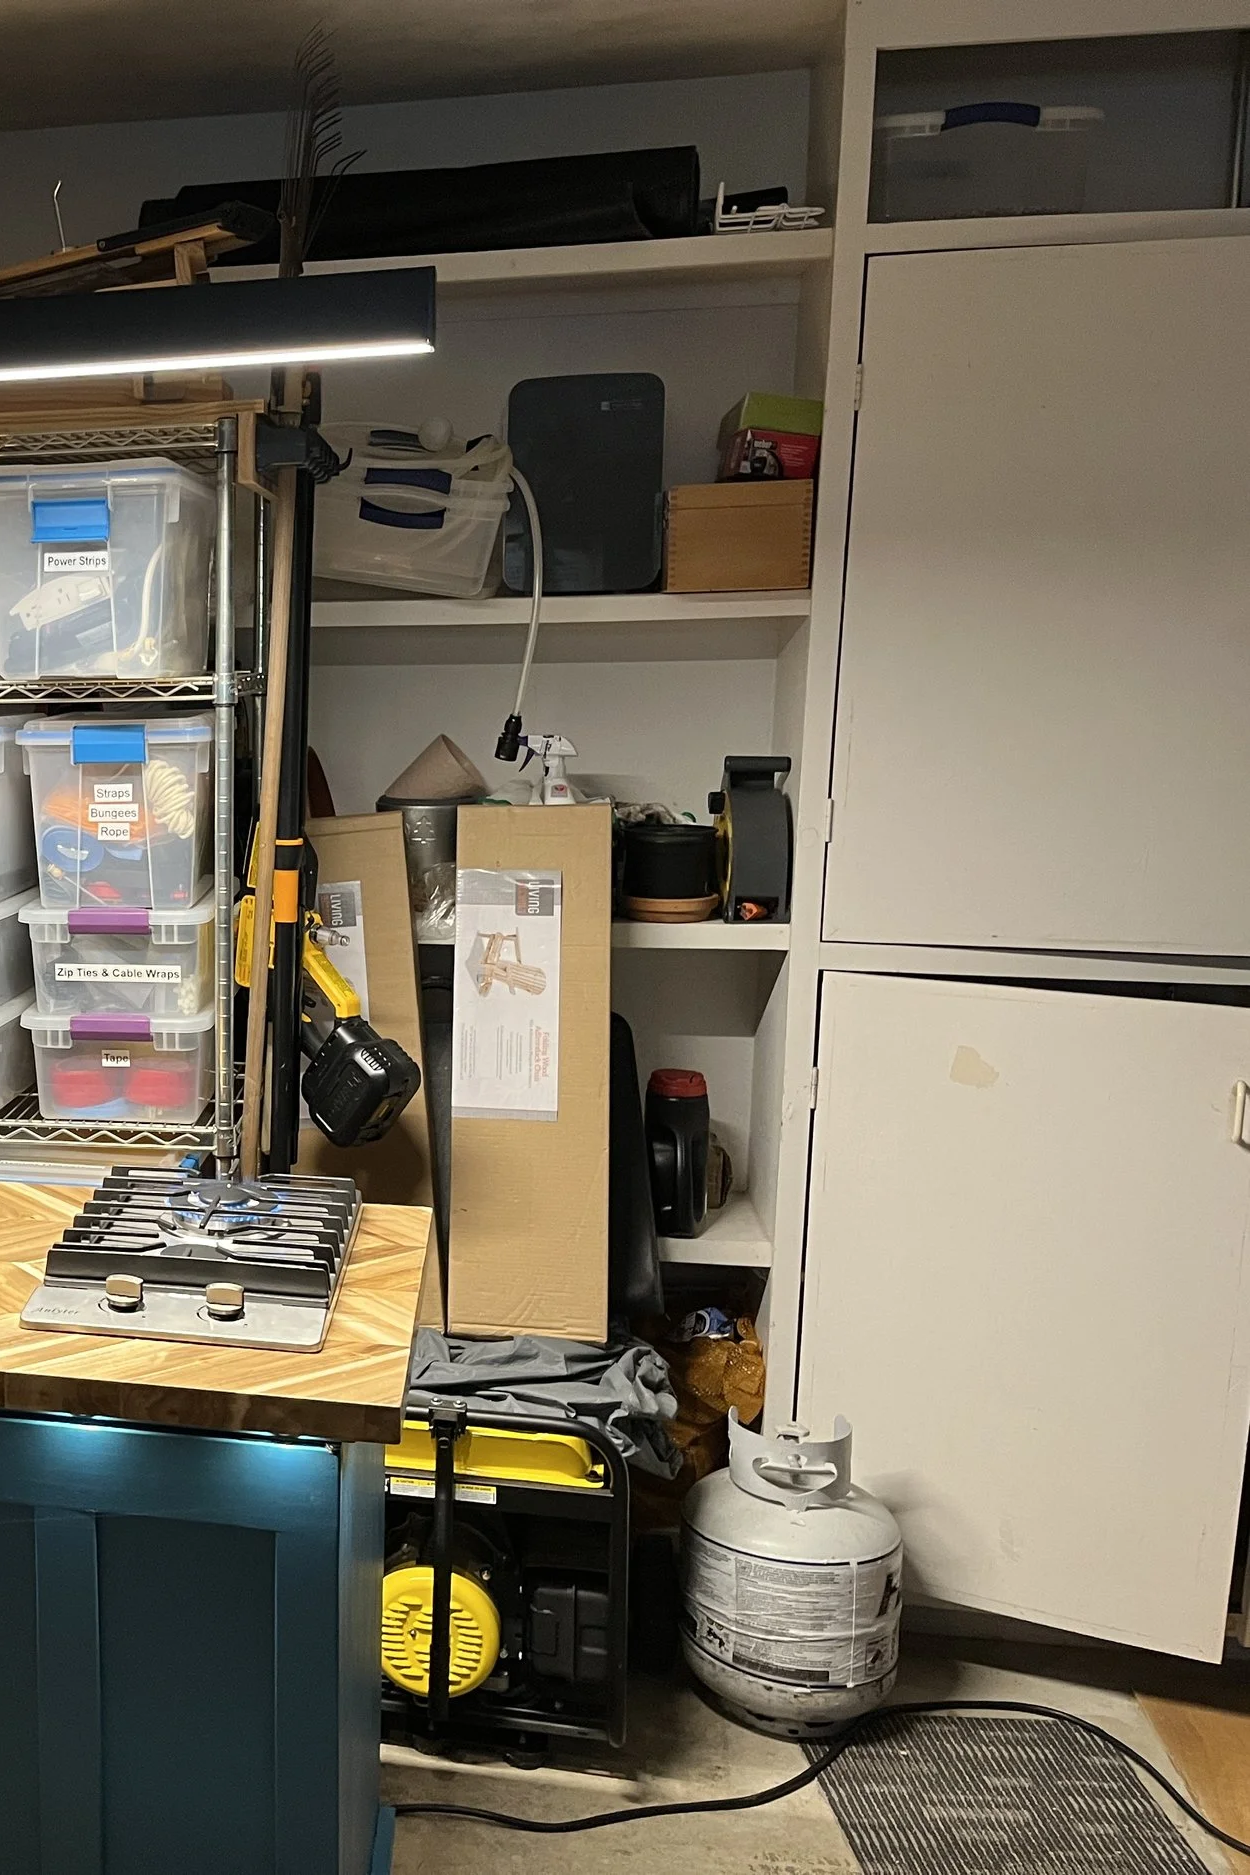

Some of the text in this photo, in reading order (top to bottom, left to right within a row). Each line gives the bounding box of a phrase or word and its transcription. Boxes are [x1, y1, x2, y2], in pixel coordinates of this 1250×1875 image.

[47, 556, 107, 569] Power Strips
[96, 788, 131, 799] Straps
[90, 808, 137, 820] Bungees
[100, 826, 129, 838] Rope
[57, 967, 180, 981] Zip Ties & Cable Wraps
[103, 1052, 129, 1065] Tape
